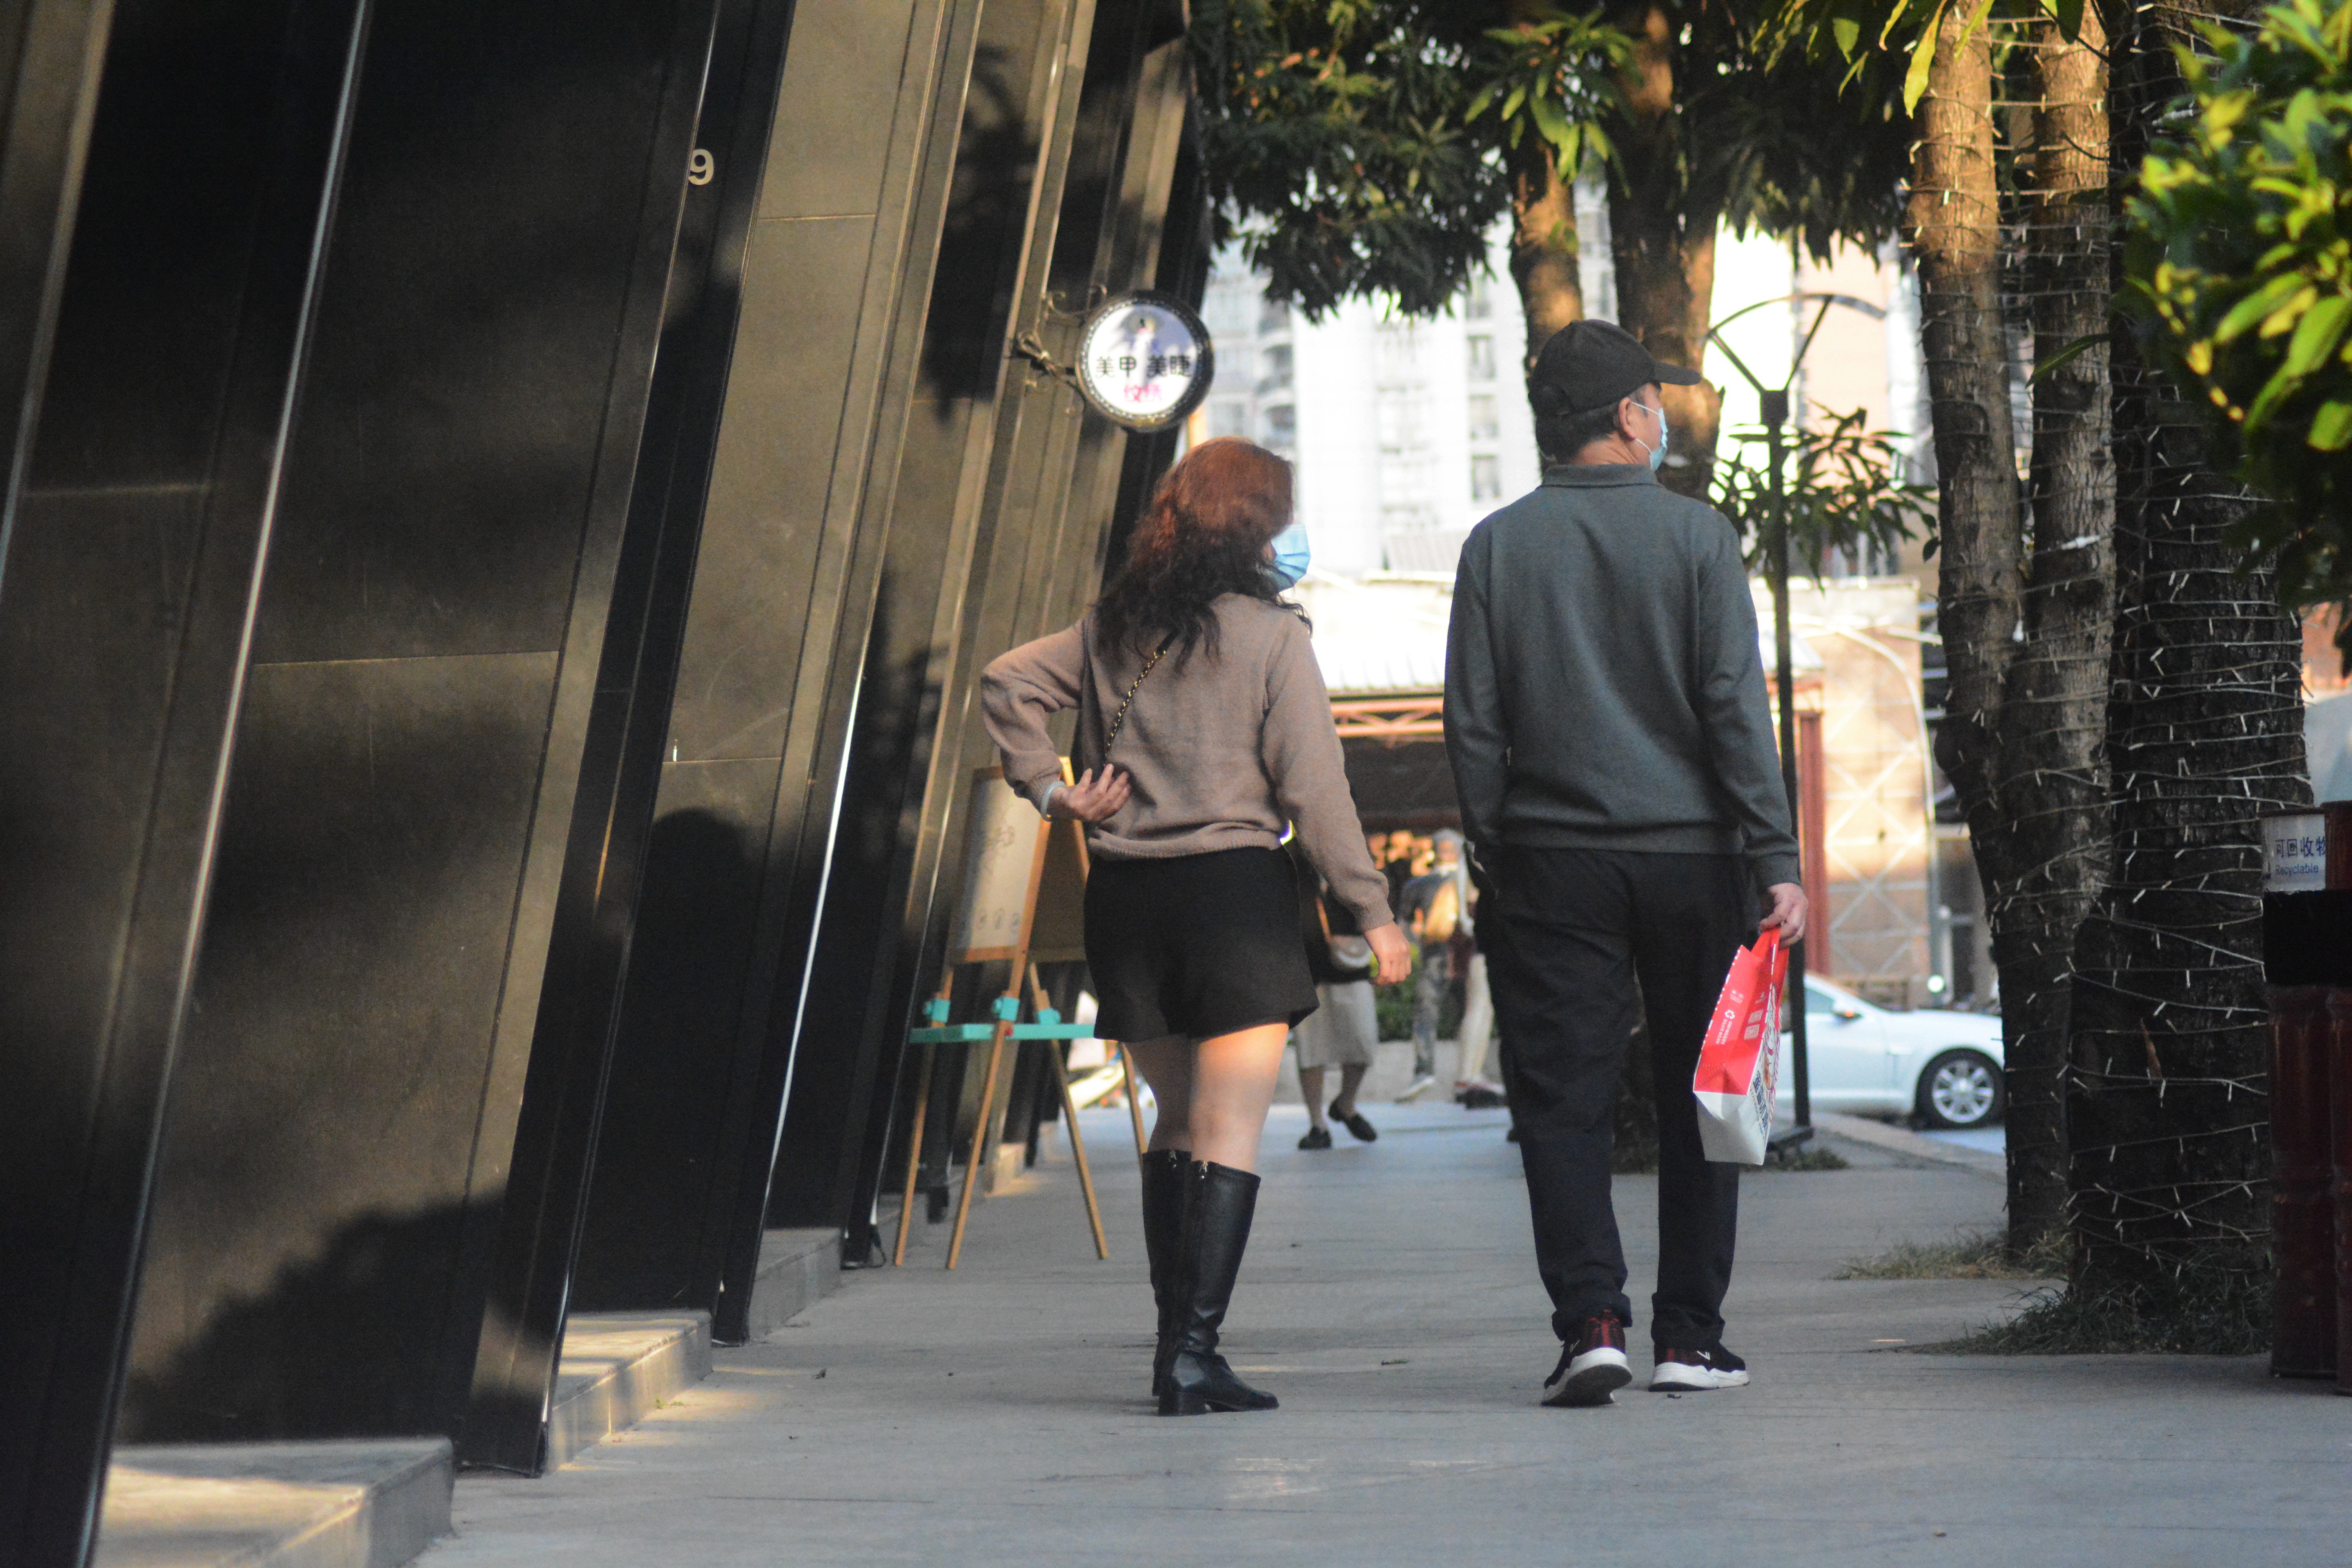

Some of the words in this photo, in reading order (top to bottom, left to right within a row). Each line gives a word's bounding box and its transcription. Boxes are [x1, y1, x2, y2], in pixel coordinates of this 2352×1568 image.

[688, 149, 714, 185] 9
[1096, 356, 1136, 378] 美甲
[2275, 837, 2325, 858] 可回收物
[2276, 864, 2319, 877] Recyclable
